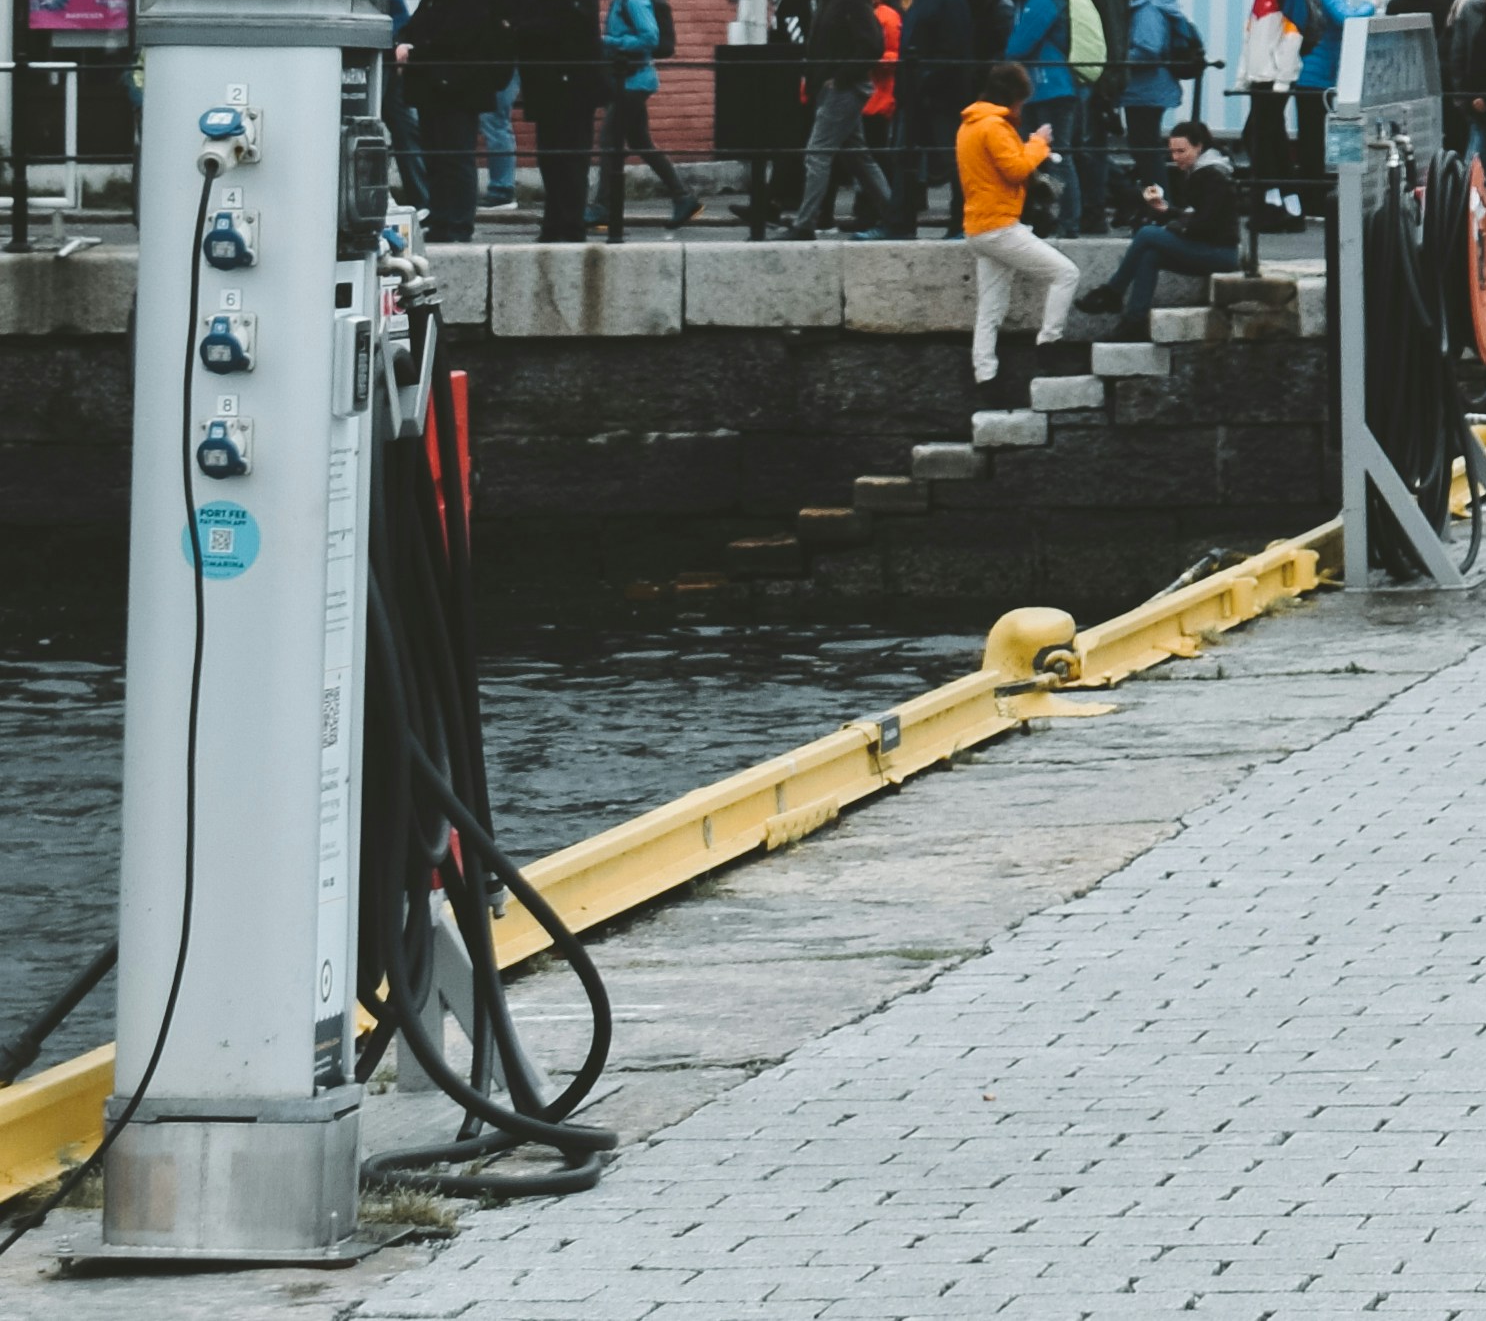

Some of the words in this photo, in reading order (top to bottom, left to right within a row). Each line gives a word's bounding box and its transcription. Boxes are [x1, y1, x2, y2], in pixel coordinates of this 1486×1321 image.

[232, 88, 242, 102] 2
[227, 191, 236, 203] 4
[226, 292, 236, 306] 6
[222, 398, 232, 413] 8
[200, 508, 226, 518] PORT
[229, 510, 247, 519] FEE
